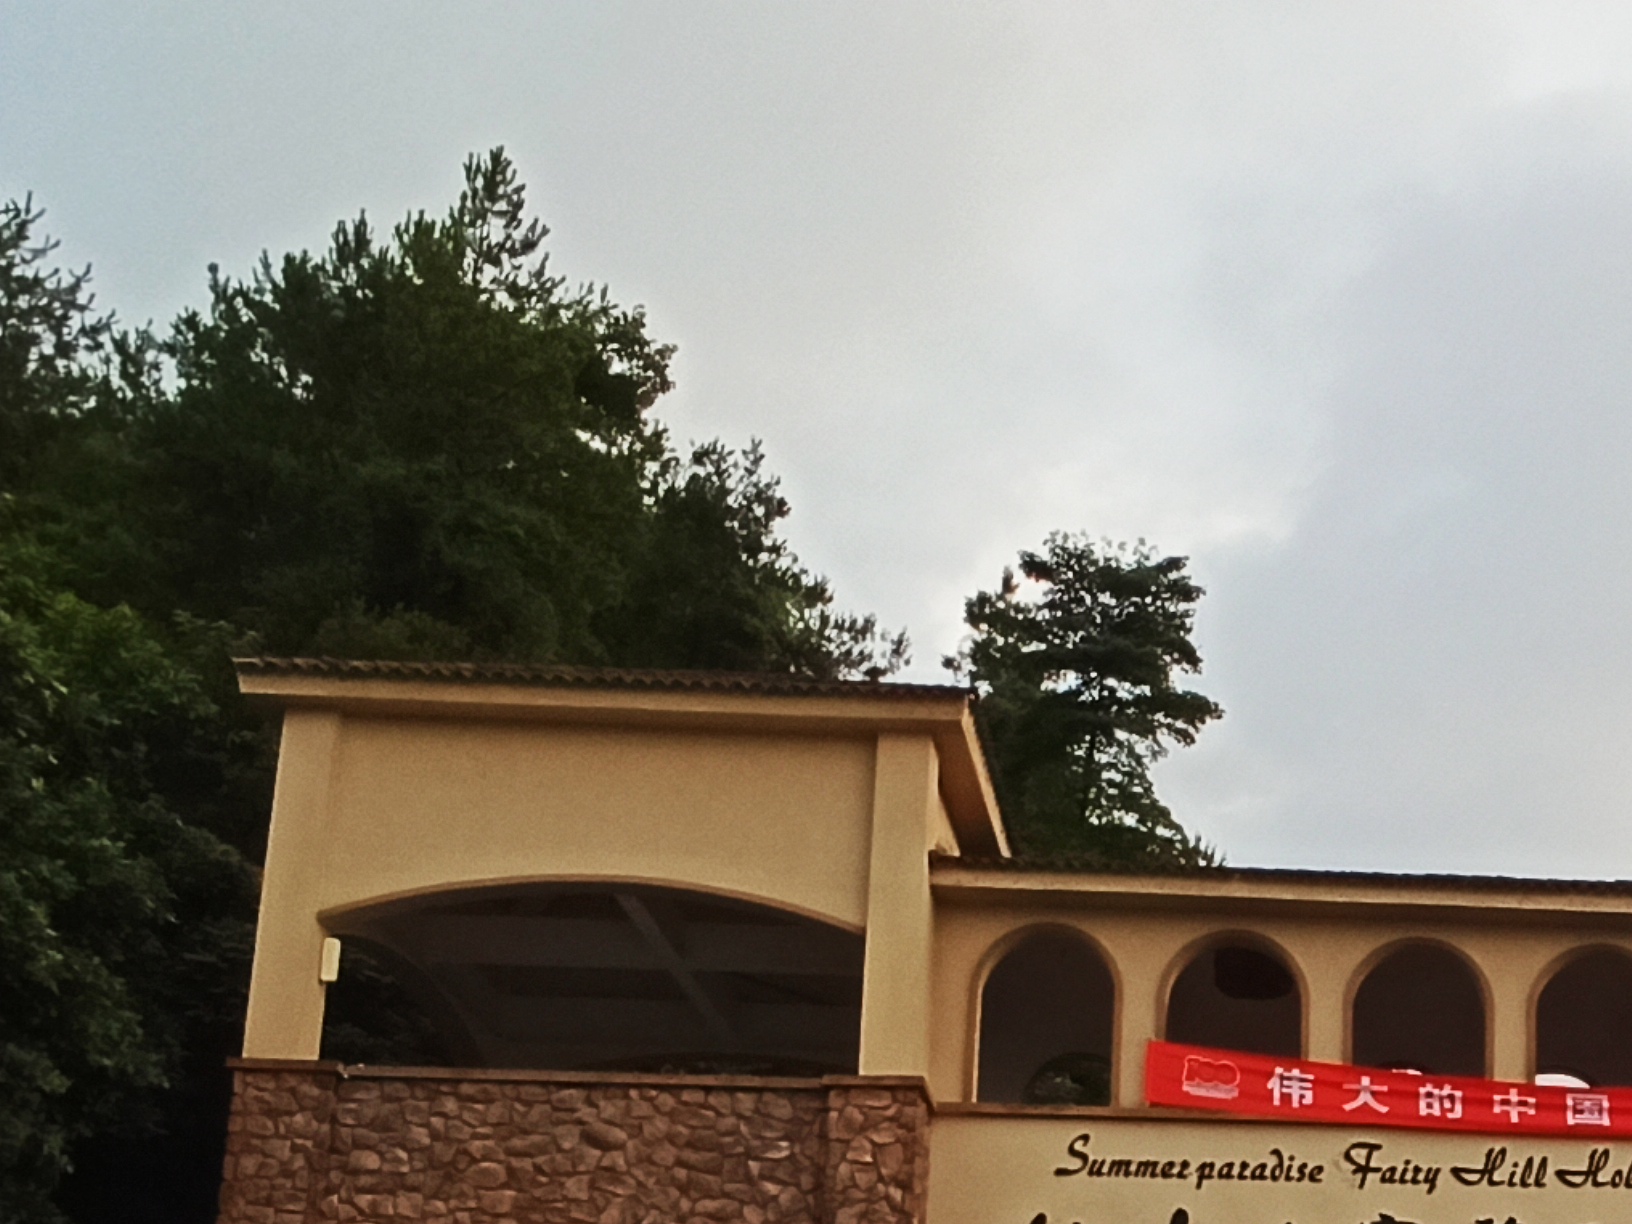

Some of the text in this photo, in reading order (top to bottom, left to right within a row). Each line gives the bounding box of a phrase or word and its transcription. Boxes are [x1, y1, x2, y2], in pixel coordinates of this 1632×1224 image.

[1053, 1133, 1191, 1180] Summer
[1194, 1147, 1324, 1190] paradise
[1343, 1141, 1442, 1195] Fairy
[1450, 1146, 1549, 1189] Hill
